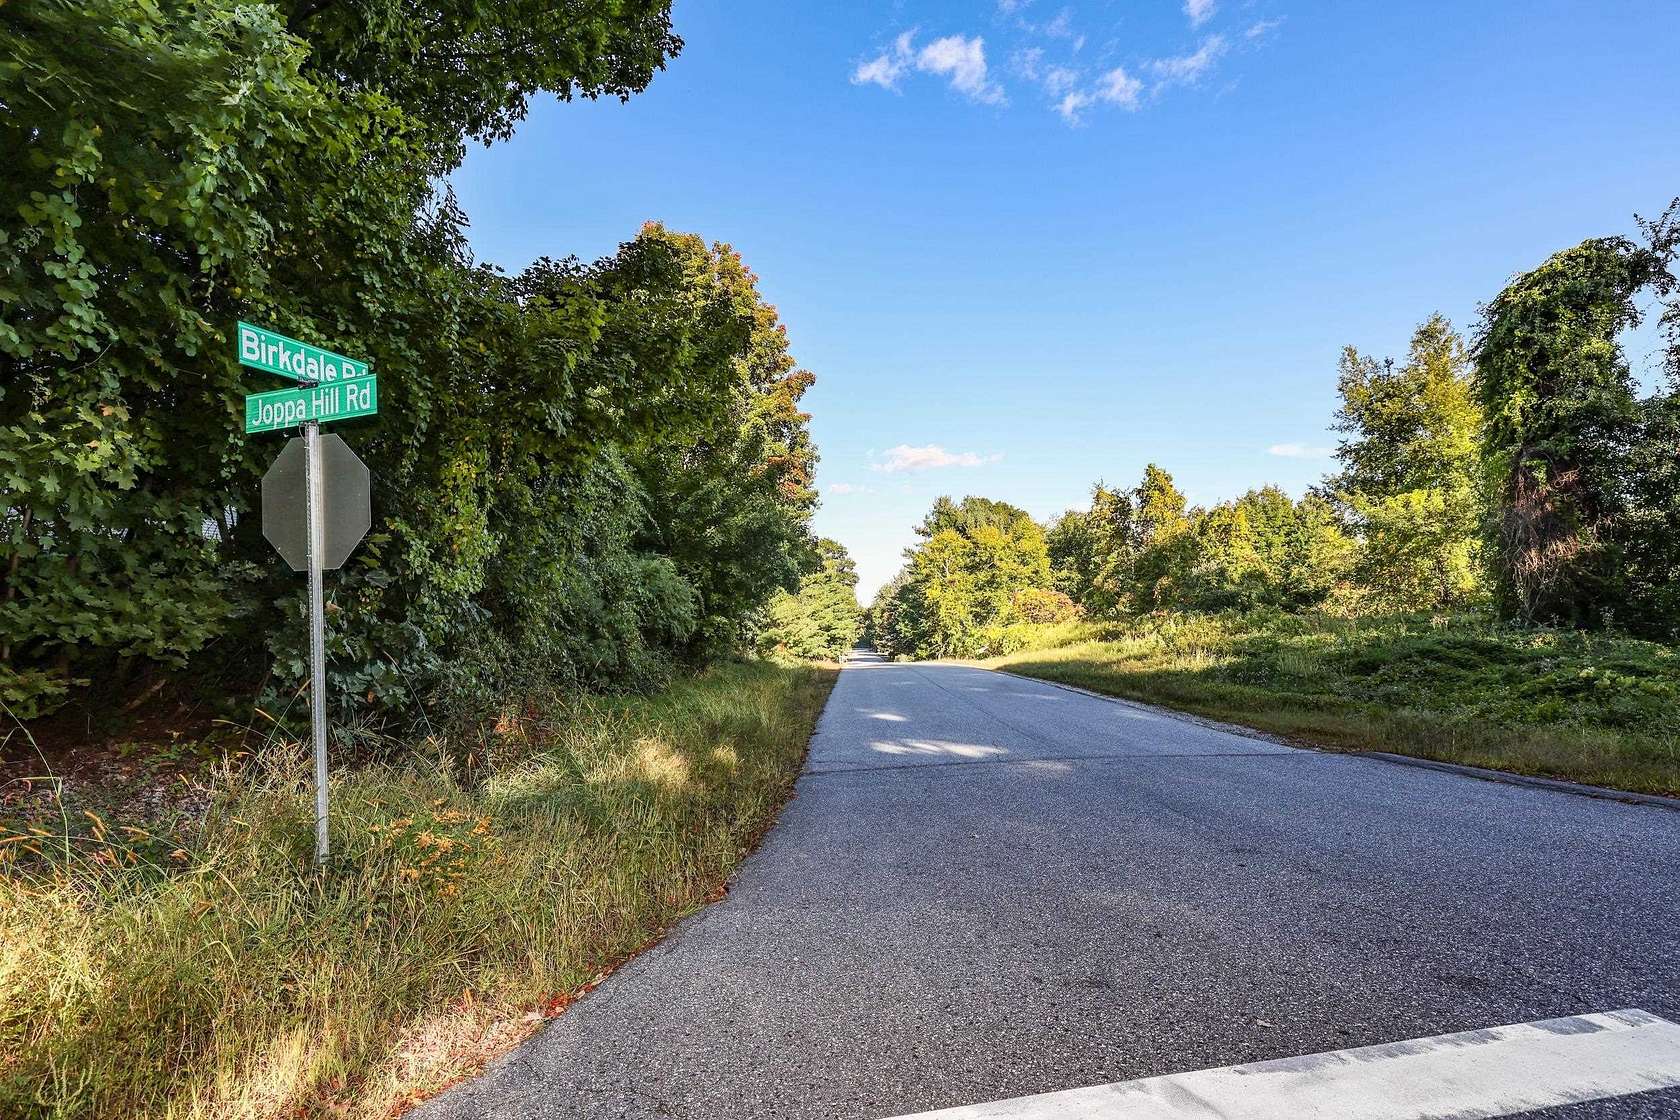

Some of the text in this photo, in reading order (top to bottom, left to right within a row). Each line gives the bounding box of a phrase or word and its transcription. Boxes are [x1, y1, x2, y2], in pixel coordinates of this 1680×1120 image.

[241, 328, 366, 381] Birkdale R
[252, 381, 371, 429] Joppa Hill Rd
